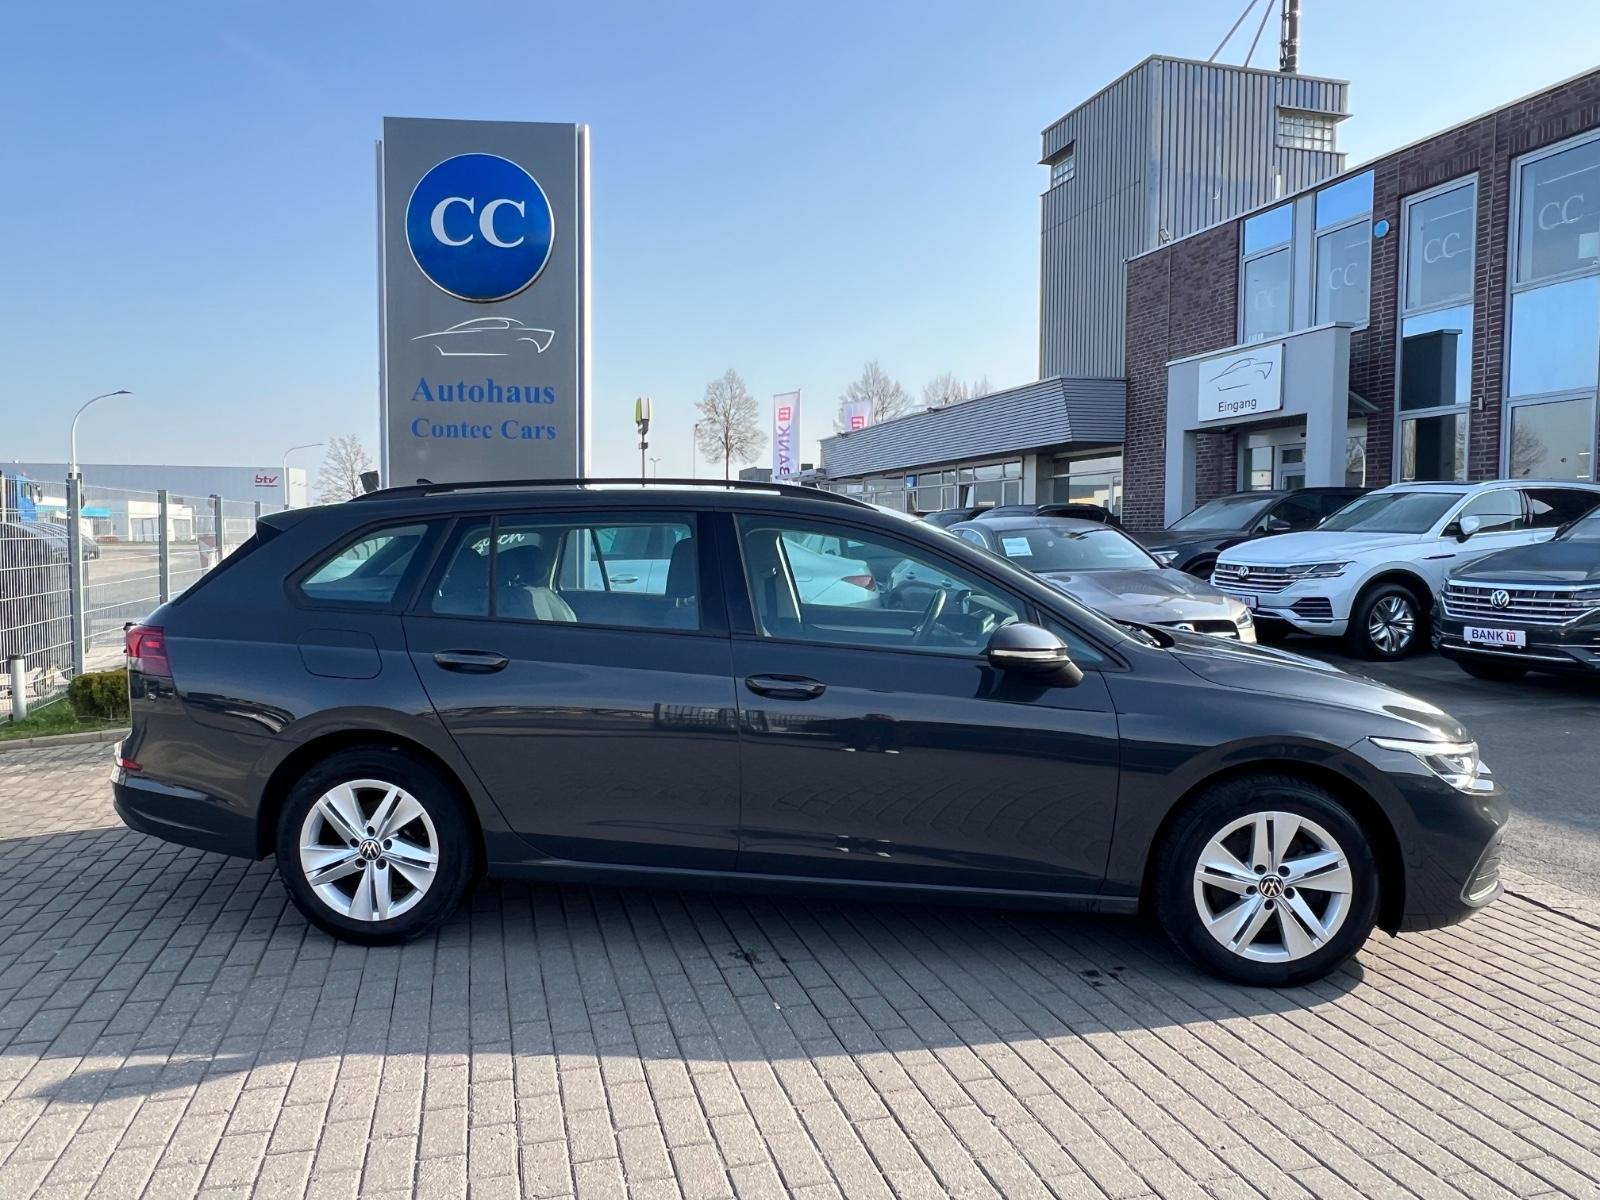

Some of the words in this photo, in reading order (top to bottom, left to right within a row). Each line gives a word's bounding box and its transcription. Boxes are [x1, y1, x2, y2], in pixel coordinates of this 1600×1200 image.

[430, 196, 525, 248] CC
[411, 377, 556, 404] Autohaus
[1218, 398, 1257, 413] Eingang
[411, 418, 493, 439] Contec
[501, 419, 556, 440] Cars
[255, 474, 278, 484] btv
[1471, 628, 1504, 641] BANK
